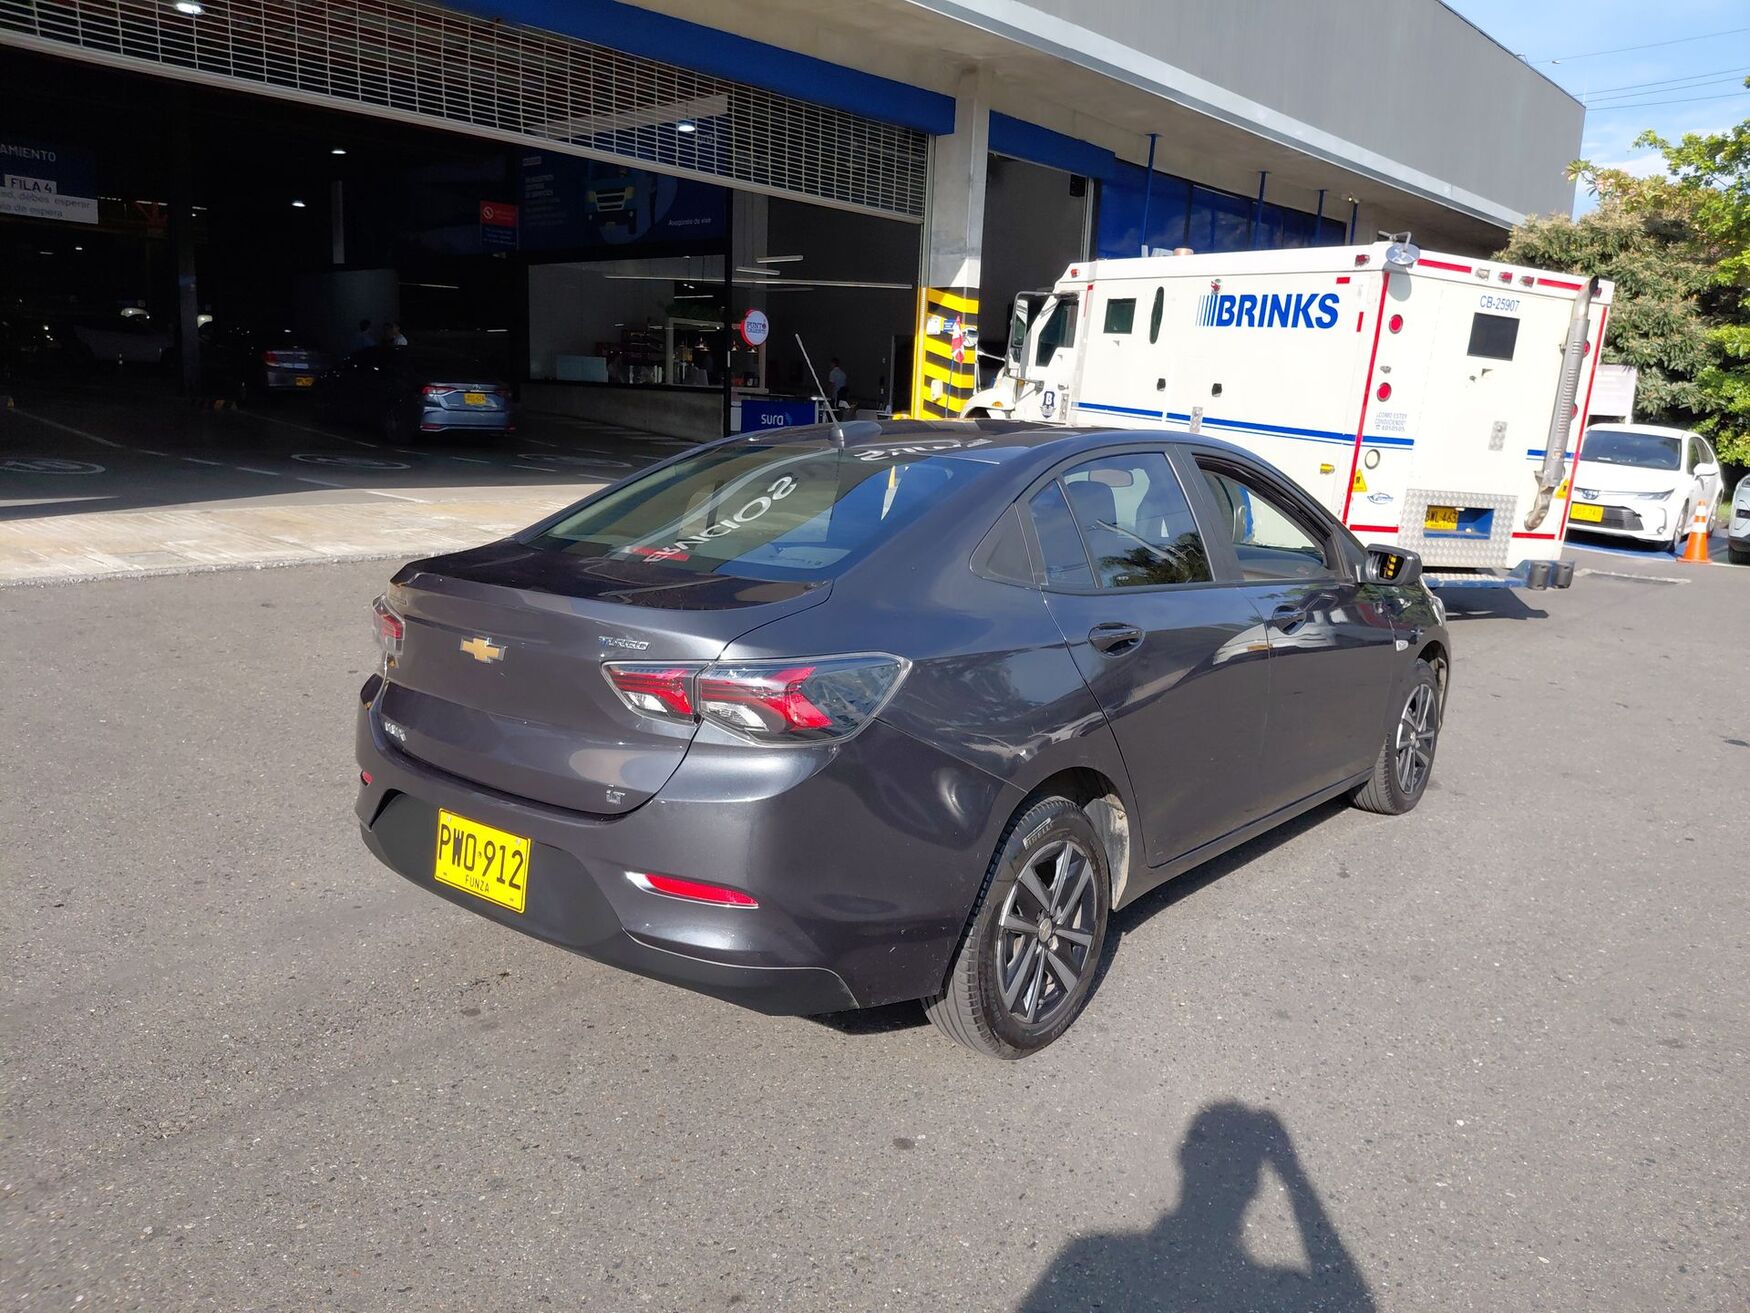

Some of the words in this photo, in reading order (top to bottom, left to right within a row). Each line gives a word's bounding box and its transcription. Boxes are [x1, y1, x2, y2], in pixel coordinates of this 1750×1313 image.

[11, 178, 41, 193] FILA
[44, 183, 52, 193] 4
[1216, 293, 1340, 329] BRINKS
[1479, 295, 1521, 312] CB-25907
[761, 414, 784, 426] sura
[465, 874, 490, 893] FUNZA
